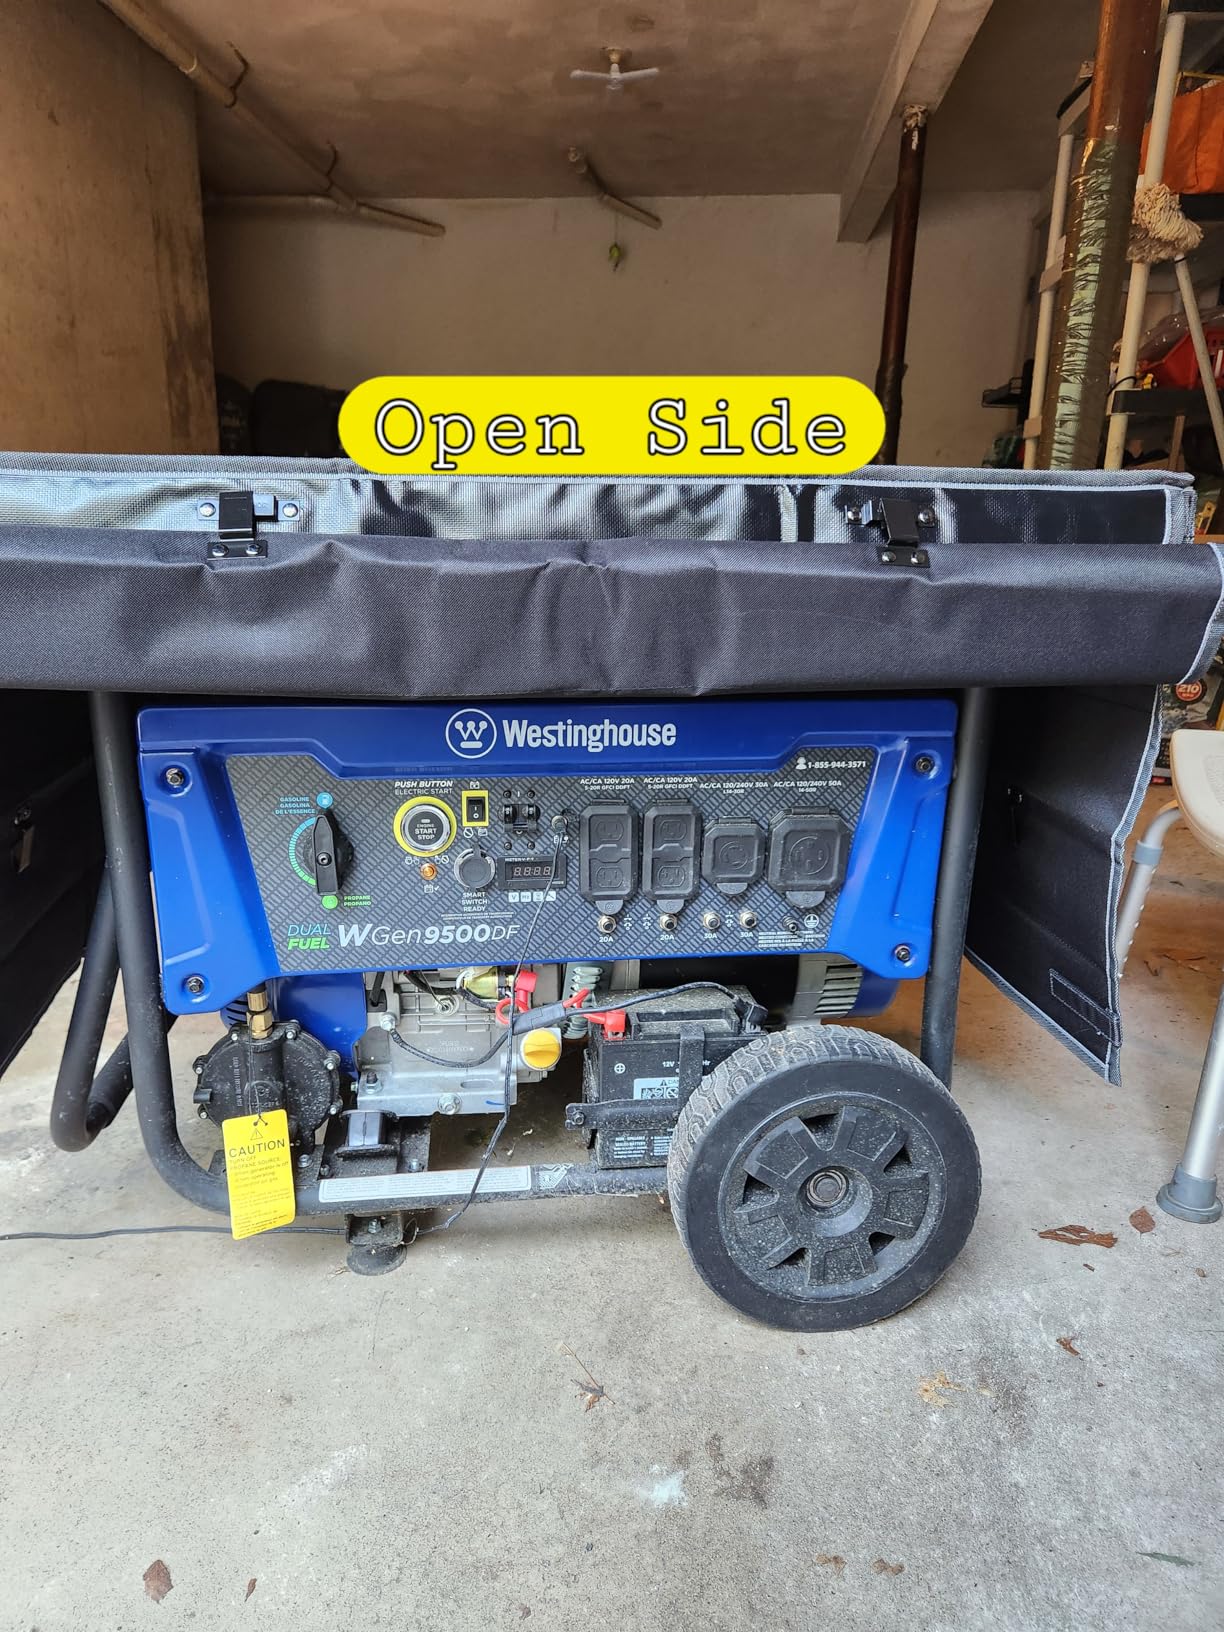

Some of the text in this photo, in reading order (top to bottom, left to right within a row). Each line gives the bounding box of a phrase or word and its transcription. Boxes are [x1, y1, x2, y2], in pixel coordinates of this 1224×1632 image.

[502, 718, 677, 752] Westinghouse
[288, 924, 331, 936] DUAL
[287, 938, 330, 950] FUEL
[229, 1138, 285, 1157] CAUTION
